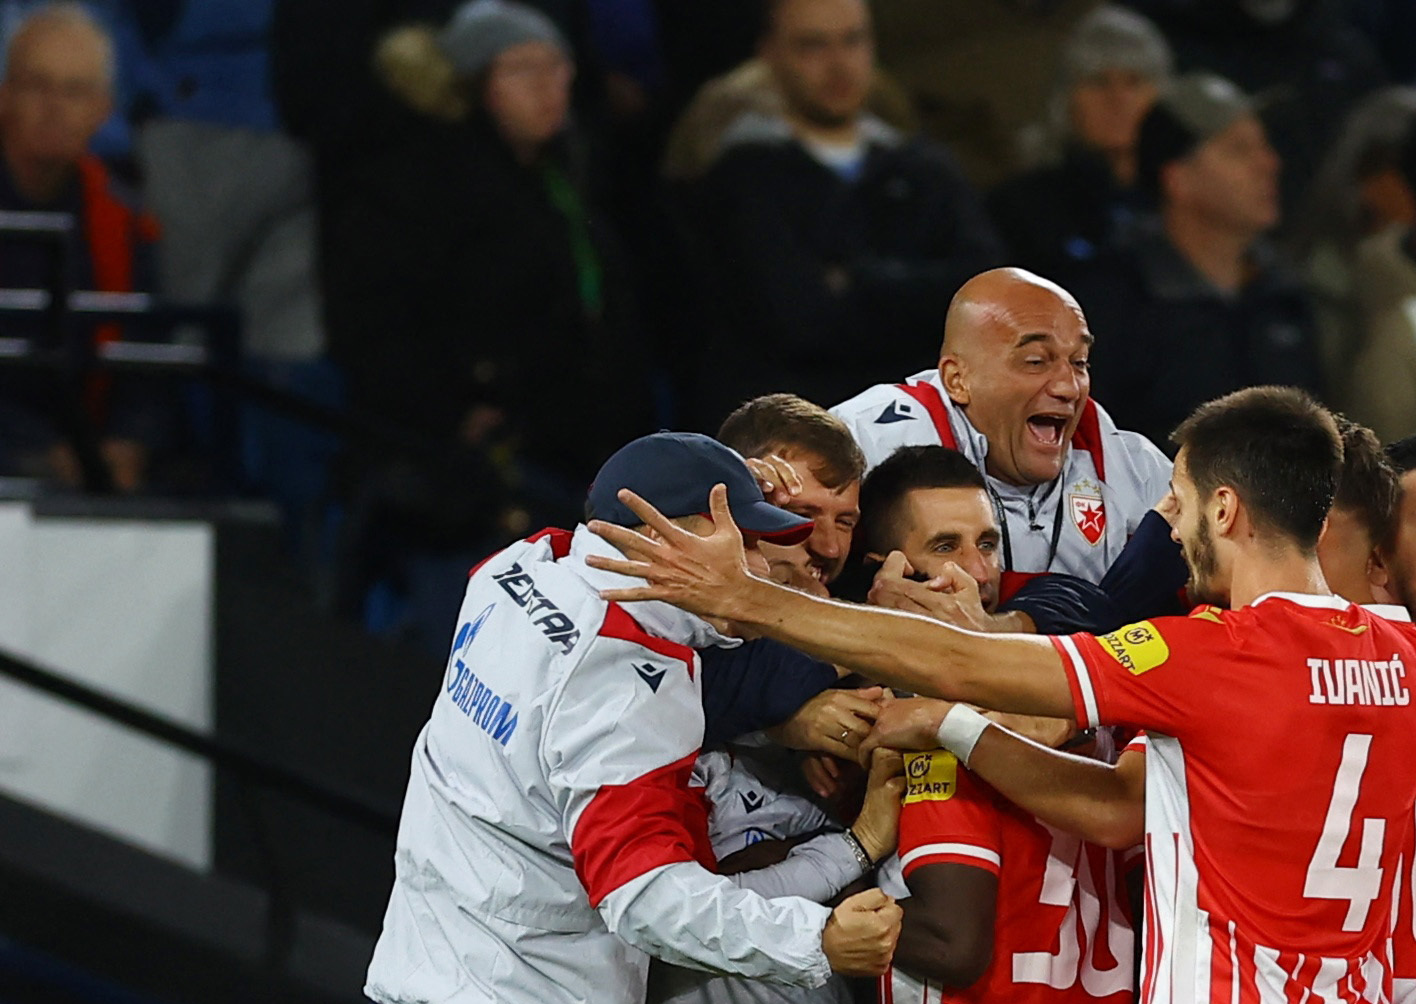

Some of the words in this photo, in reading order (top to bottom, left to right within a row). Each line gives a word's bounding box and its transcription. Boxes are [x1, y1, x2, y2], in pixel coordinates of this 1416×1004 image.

[450, 665, 519, 747] GAZPROM
[1306, 653, 1410, 706] IVANIĆ
[1302, 733, 1386, 932] 4
